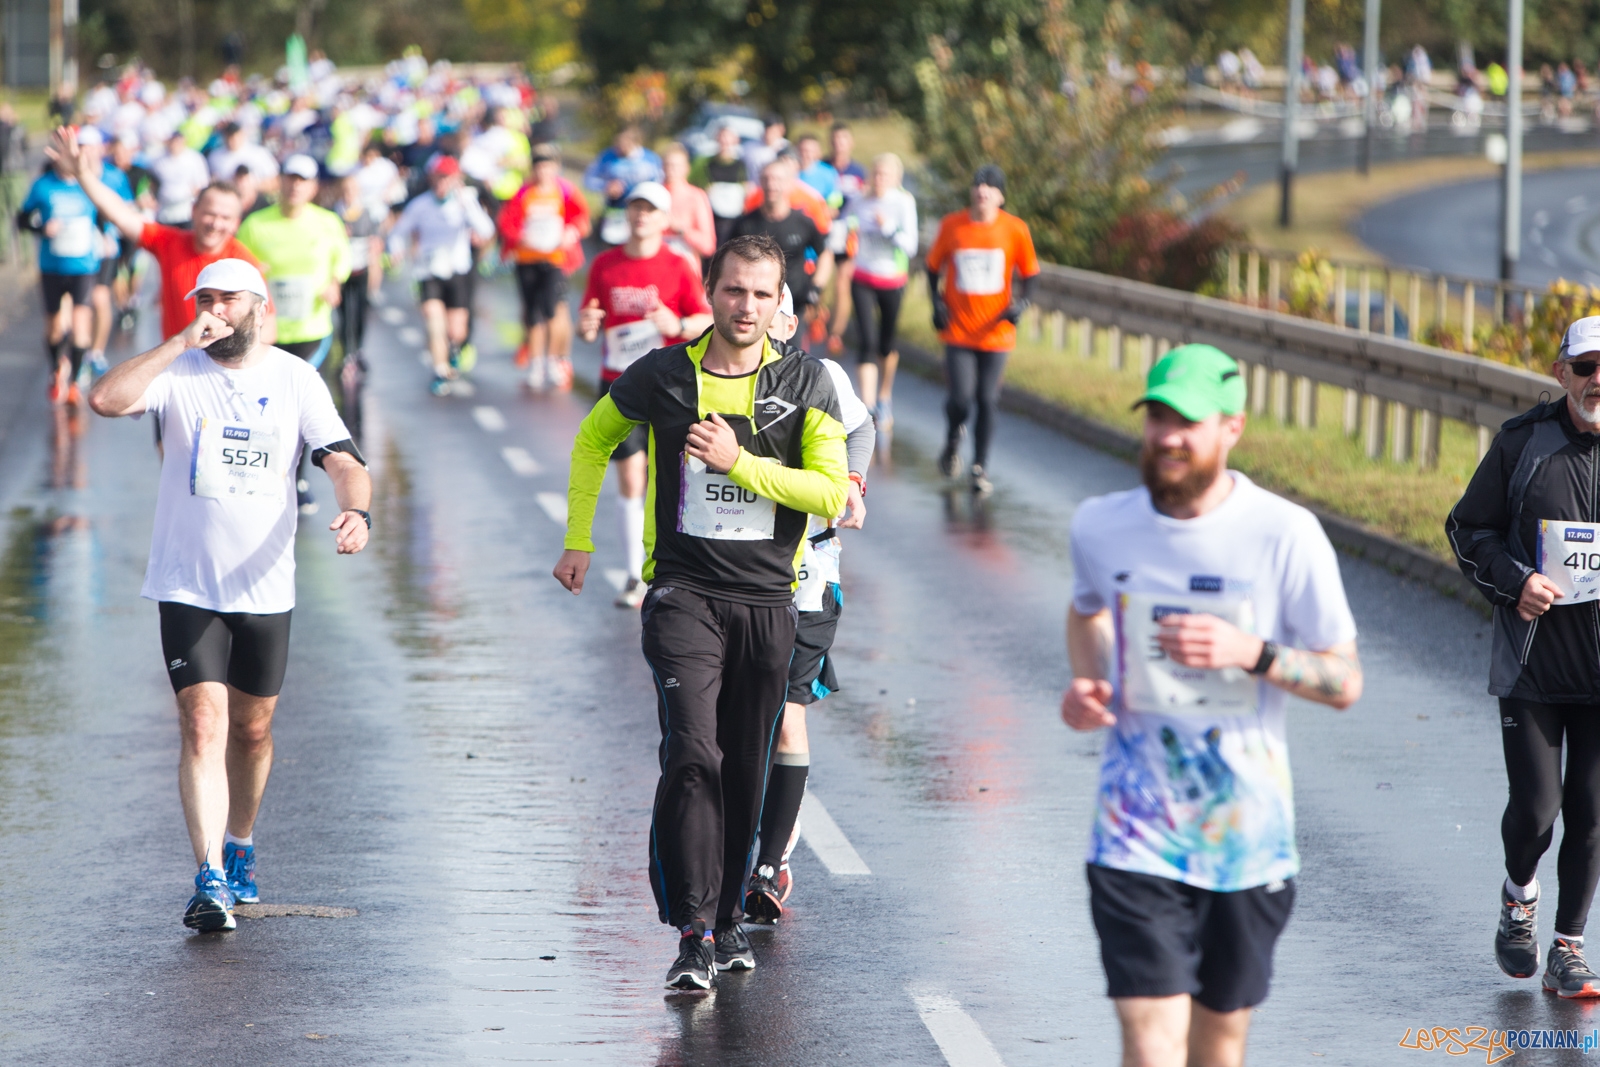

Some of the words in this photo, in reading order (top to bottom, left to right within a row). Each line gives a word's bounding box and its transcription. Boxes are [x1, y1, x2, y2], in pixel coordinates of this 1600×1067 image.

[224, 429, 248, 438] 17.PKO
[222, 448, 268, 468] 5521
[706, 484, 758, 503] 5610
[716, 506, 744, 515] Dorian
[1567, 531, 1592, 540] 17.PKO
[1564, 552, 1600, 571] 410
